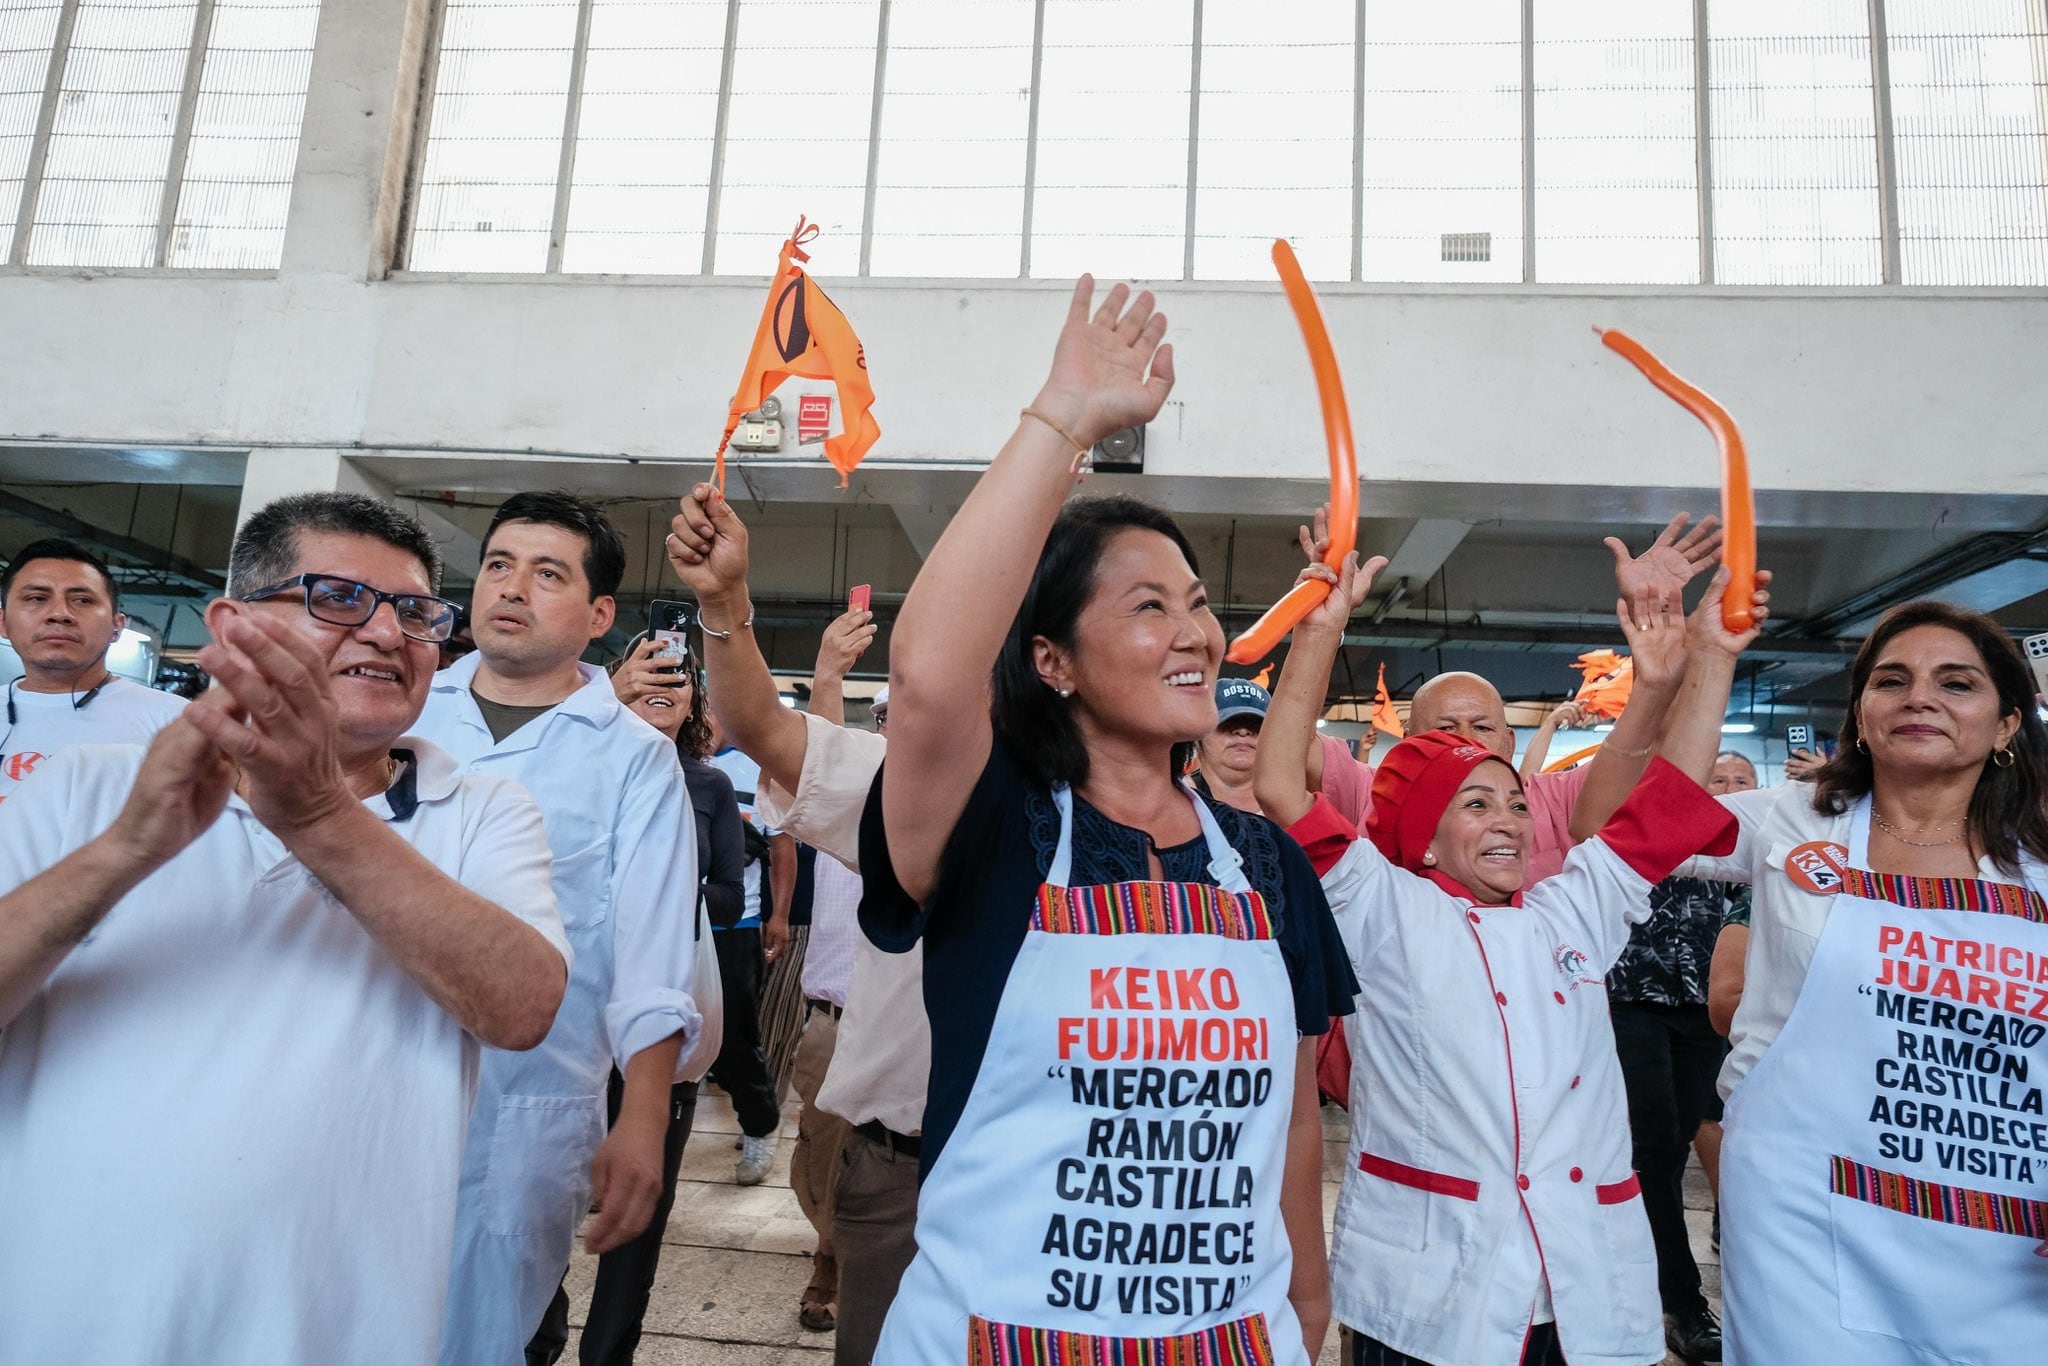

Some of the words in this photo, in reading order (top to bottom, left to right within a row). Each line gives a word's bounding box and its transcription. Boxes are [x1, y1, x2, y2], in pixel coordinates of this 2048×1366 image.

[1814, 872, 1837, 886] 4
[1090, 967, 1241, 1011] KEIKO
[1875, 959, 2048, 1021] JUAREZ
[1058, 1017, 1269, 1062] FUJIMORI
[1896, 1029, 2029, 1084] RAMÓN
[1047, 1065, 1273, 1111] “MERCADO
[1875, 1058, 2044, 1116] CASTILLA
[1086, 1109, 1244, 1163] RAMÓN
[1868, 1094, 2048, 1154] AGRADECE
[1056, 1157, 1254, 1211] CASTILLA
[1878, 1132, 1924, 1163] SU
[1935, 1141, 2048, 1184] VISITA”
[1041, 1213, 1255, 1266] AGRADECE
[1046, 1268, 1103, 1312] SU
